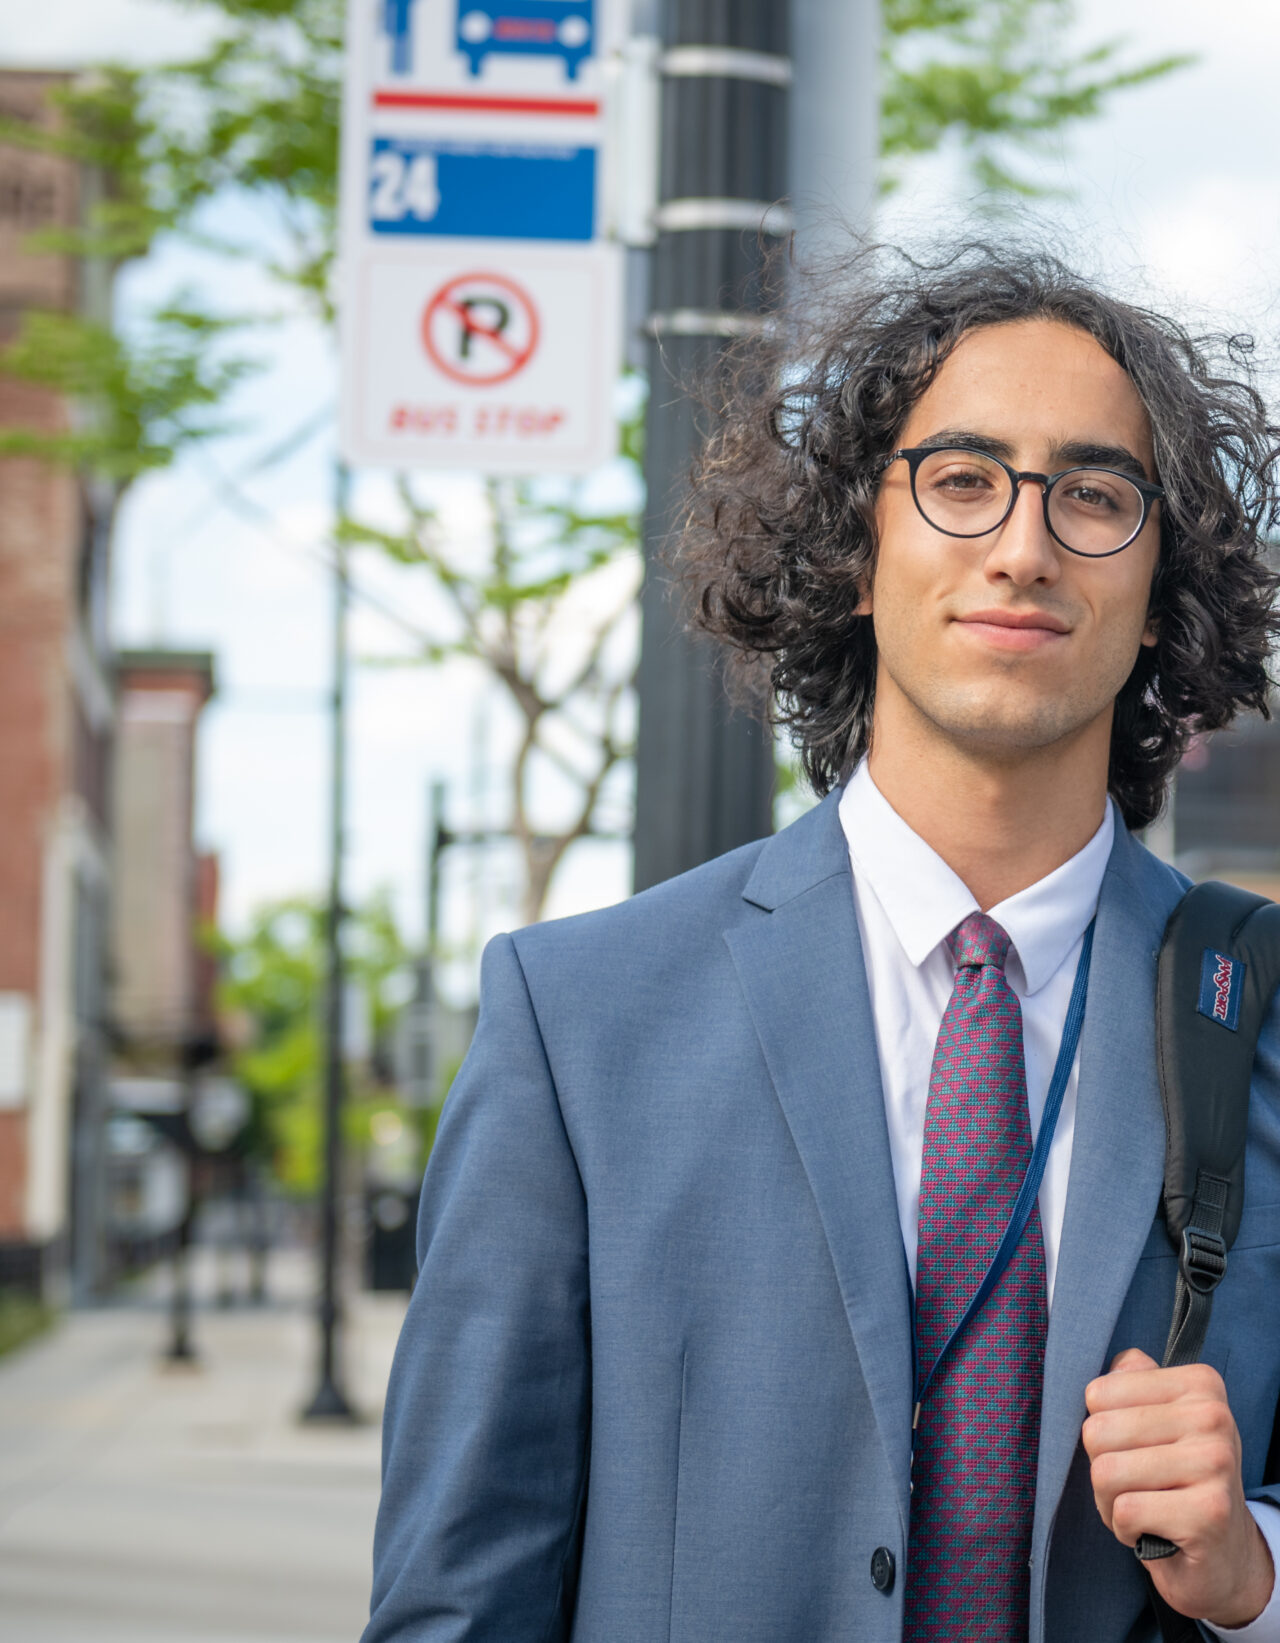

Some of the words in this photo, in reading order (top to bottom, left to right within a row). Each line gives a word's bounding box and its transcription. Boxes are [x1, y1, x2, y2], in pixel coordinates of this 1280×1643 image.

[371, 152, 439, 220] 24
[459, 297, 509, 358] P
[389, 404, 457, 433] BUS
[473, 406, 566, 437] STOP
[1213, 954, 1233, 1021] JANSPORT
